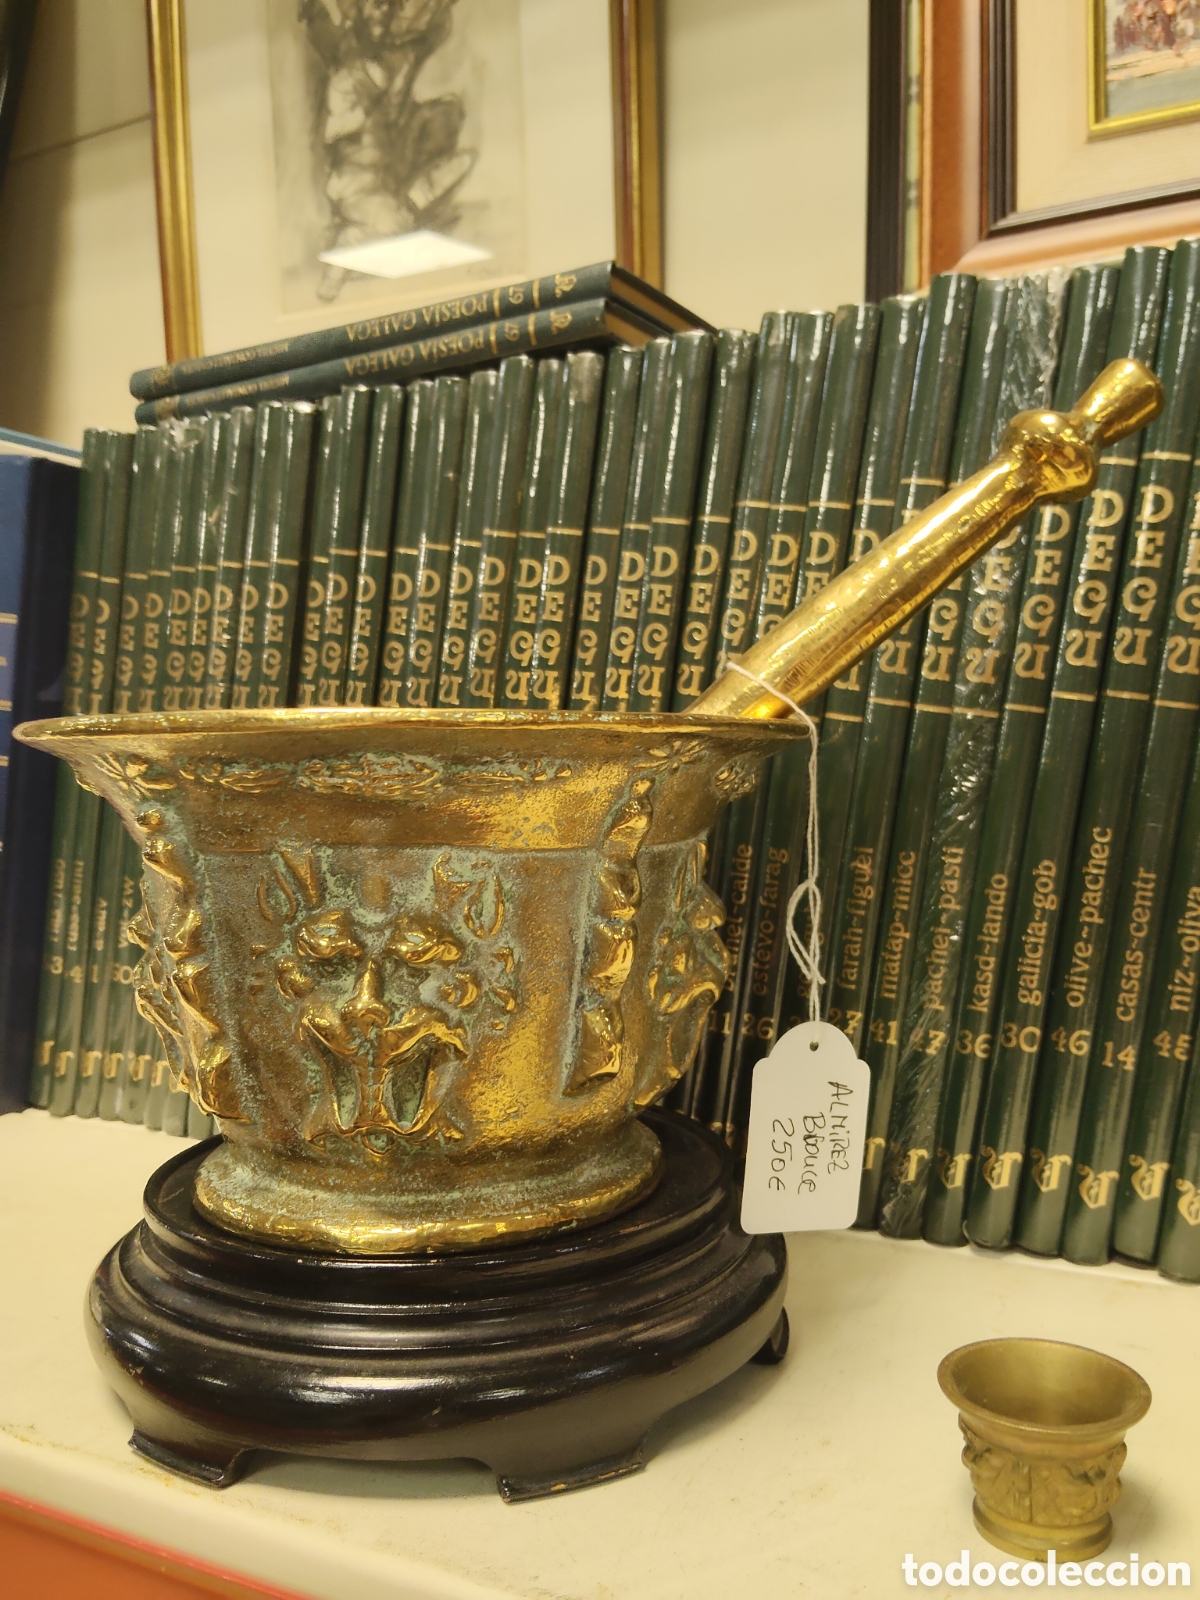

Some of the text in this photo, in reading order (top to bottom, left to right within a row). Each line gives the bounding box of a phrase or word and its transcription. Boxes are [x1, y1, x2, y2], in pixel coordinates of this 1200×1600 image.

[345, 310, 416, 342] GALEGA
[343, 345, 415, 377] GALEGA
[709, 1009, 731, 1035] 11
[741, 1012, 775, 1040] 26
[870, 1018, 898, 1045] 41
[956, 1029, 992, 1059] 36
[1001, 1022, 1041, 1053] 30
[1051, 1026, 1091, 1056] 46
[1153, 1029, 1193, 1062] 45
[1102, 1041, 1136, 1071] 14
[768, 1117, 795, 1191] 250€
